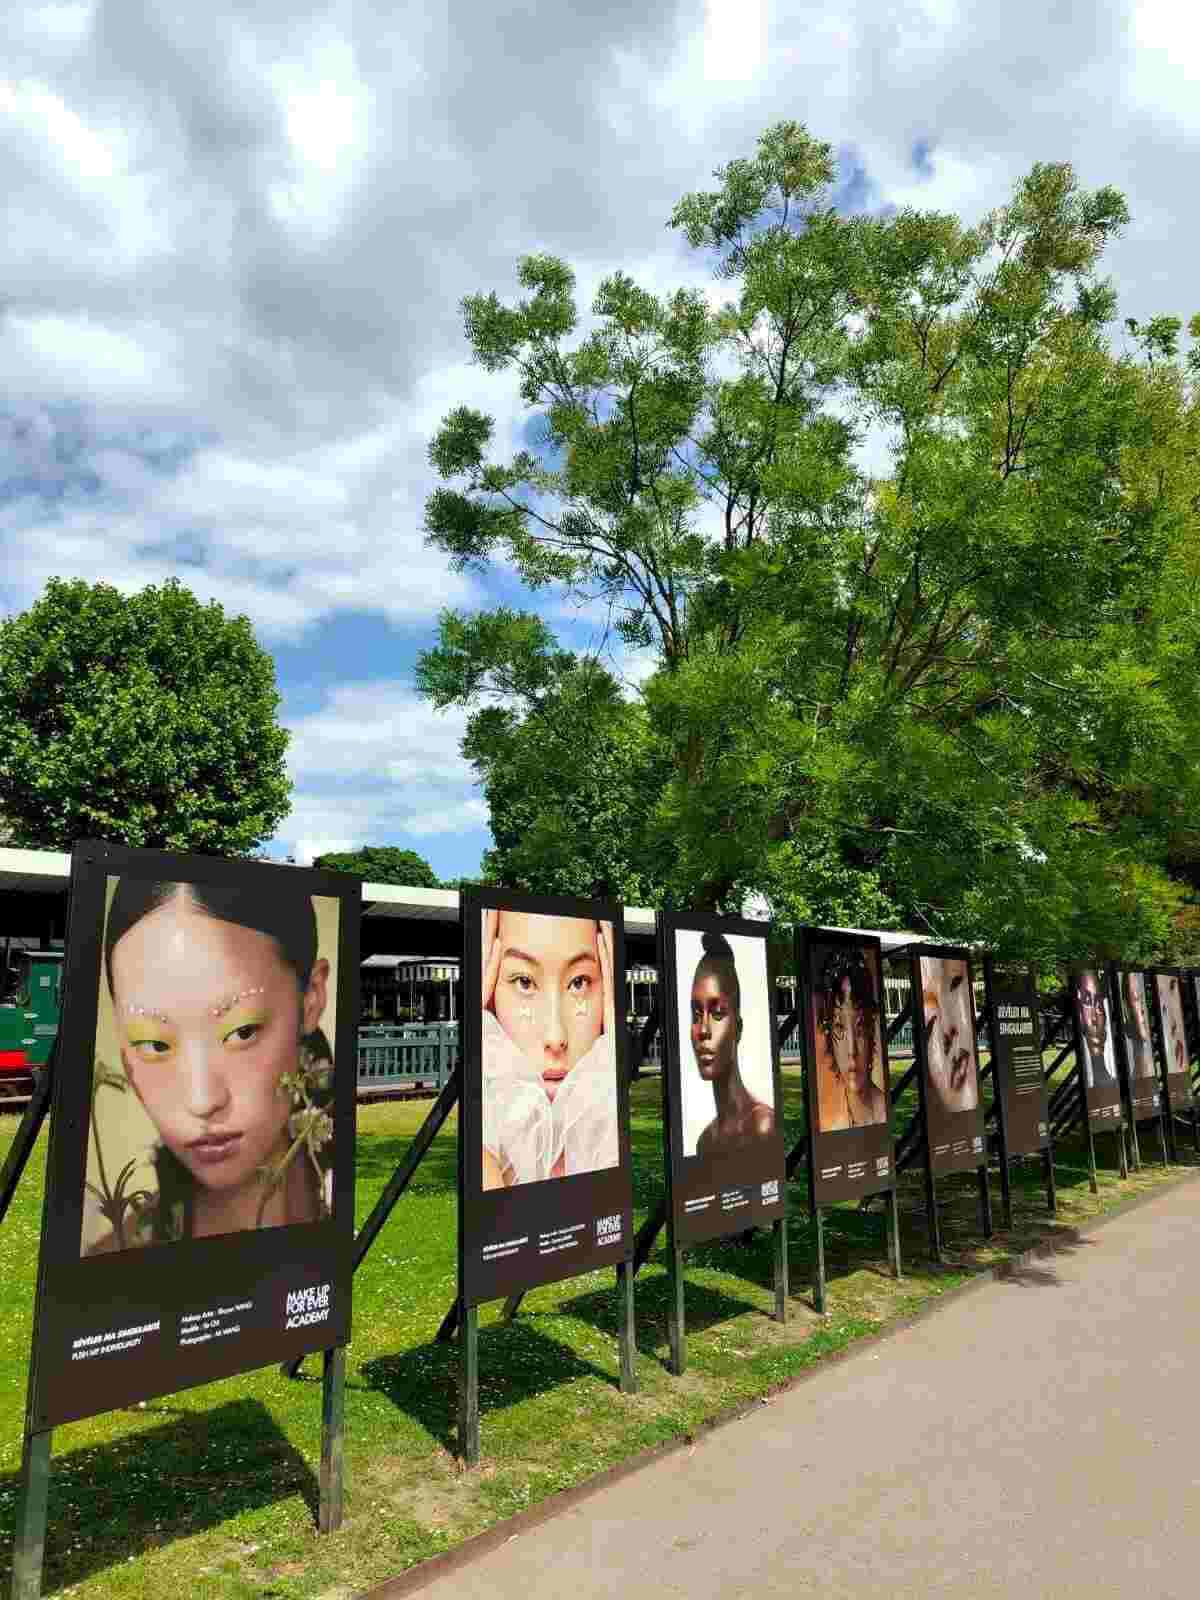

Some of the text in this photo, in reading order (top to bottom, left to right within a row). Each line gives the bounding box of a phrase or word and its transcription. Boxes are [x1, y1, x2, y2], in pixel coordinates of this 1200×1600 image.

[287, 1284, 331, 1305] MAKE UP
[287, 1295, 330, 1315] FOR EVER
[286, 1309, 331, 1329] ACADEMY
